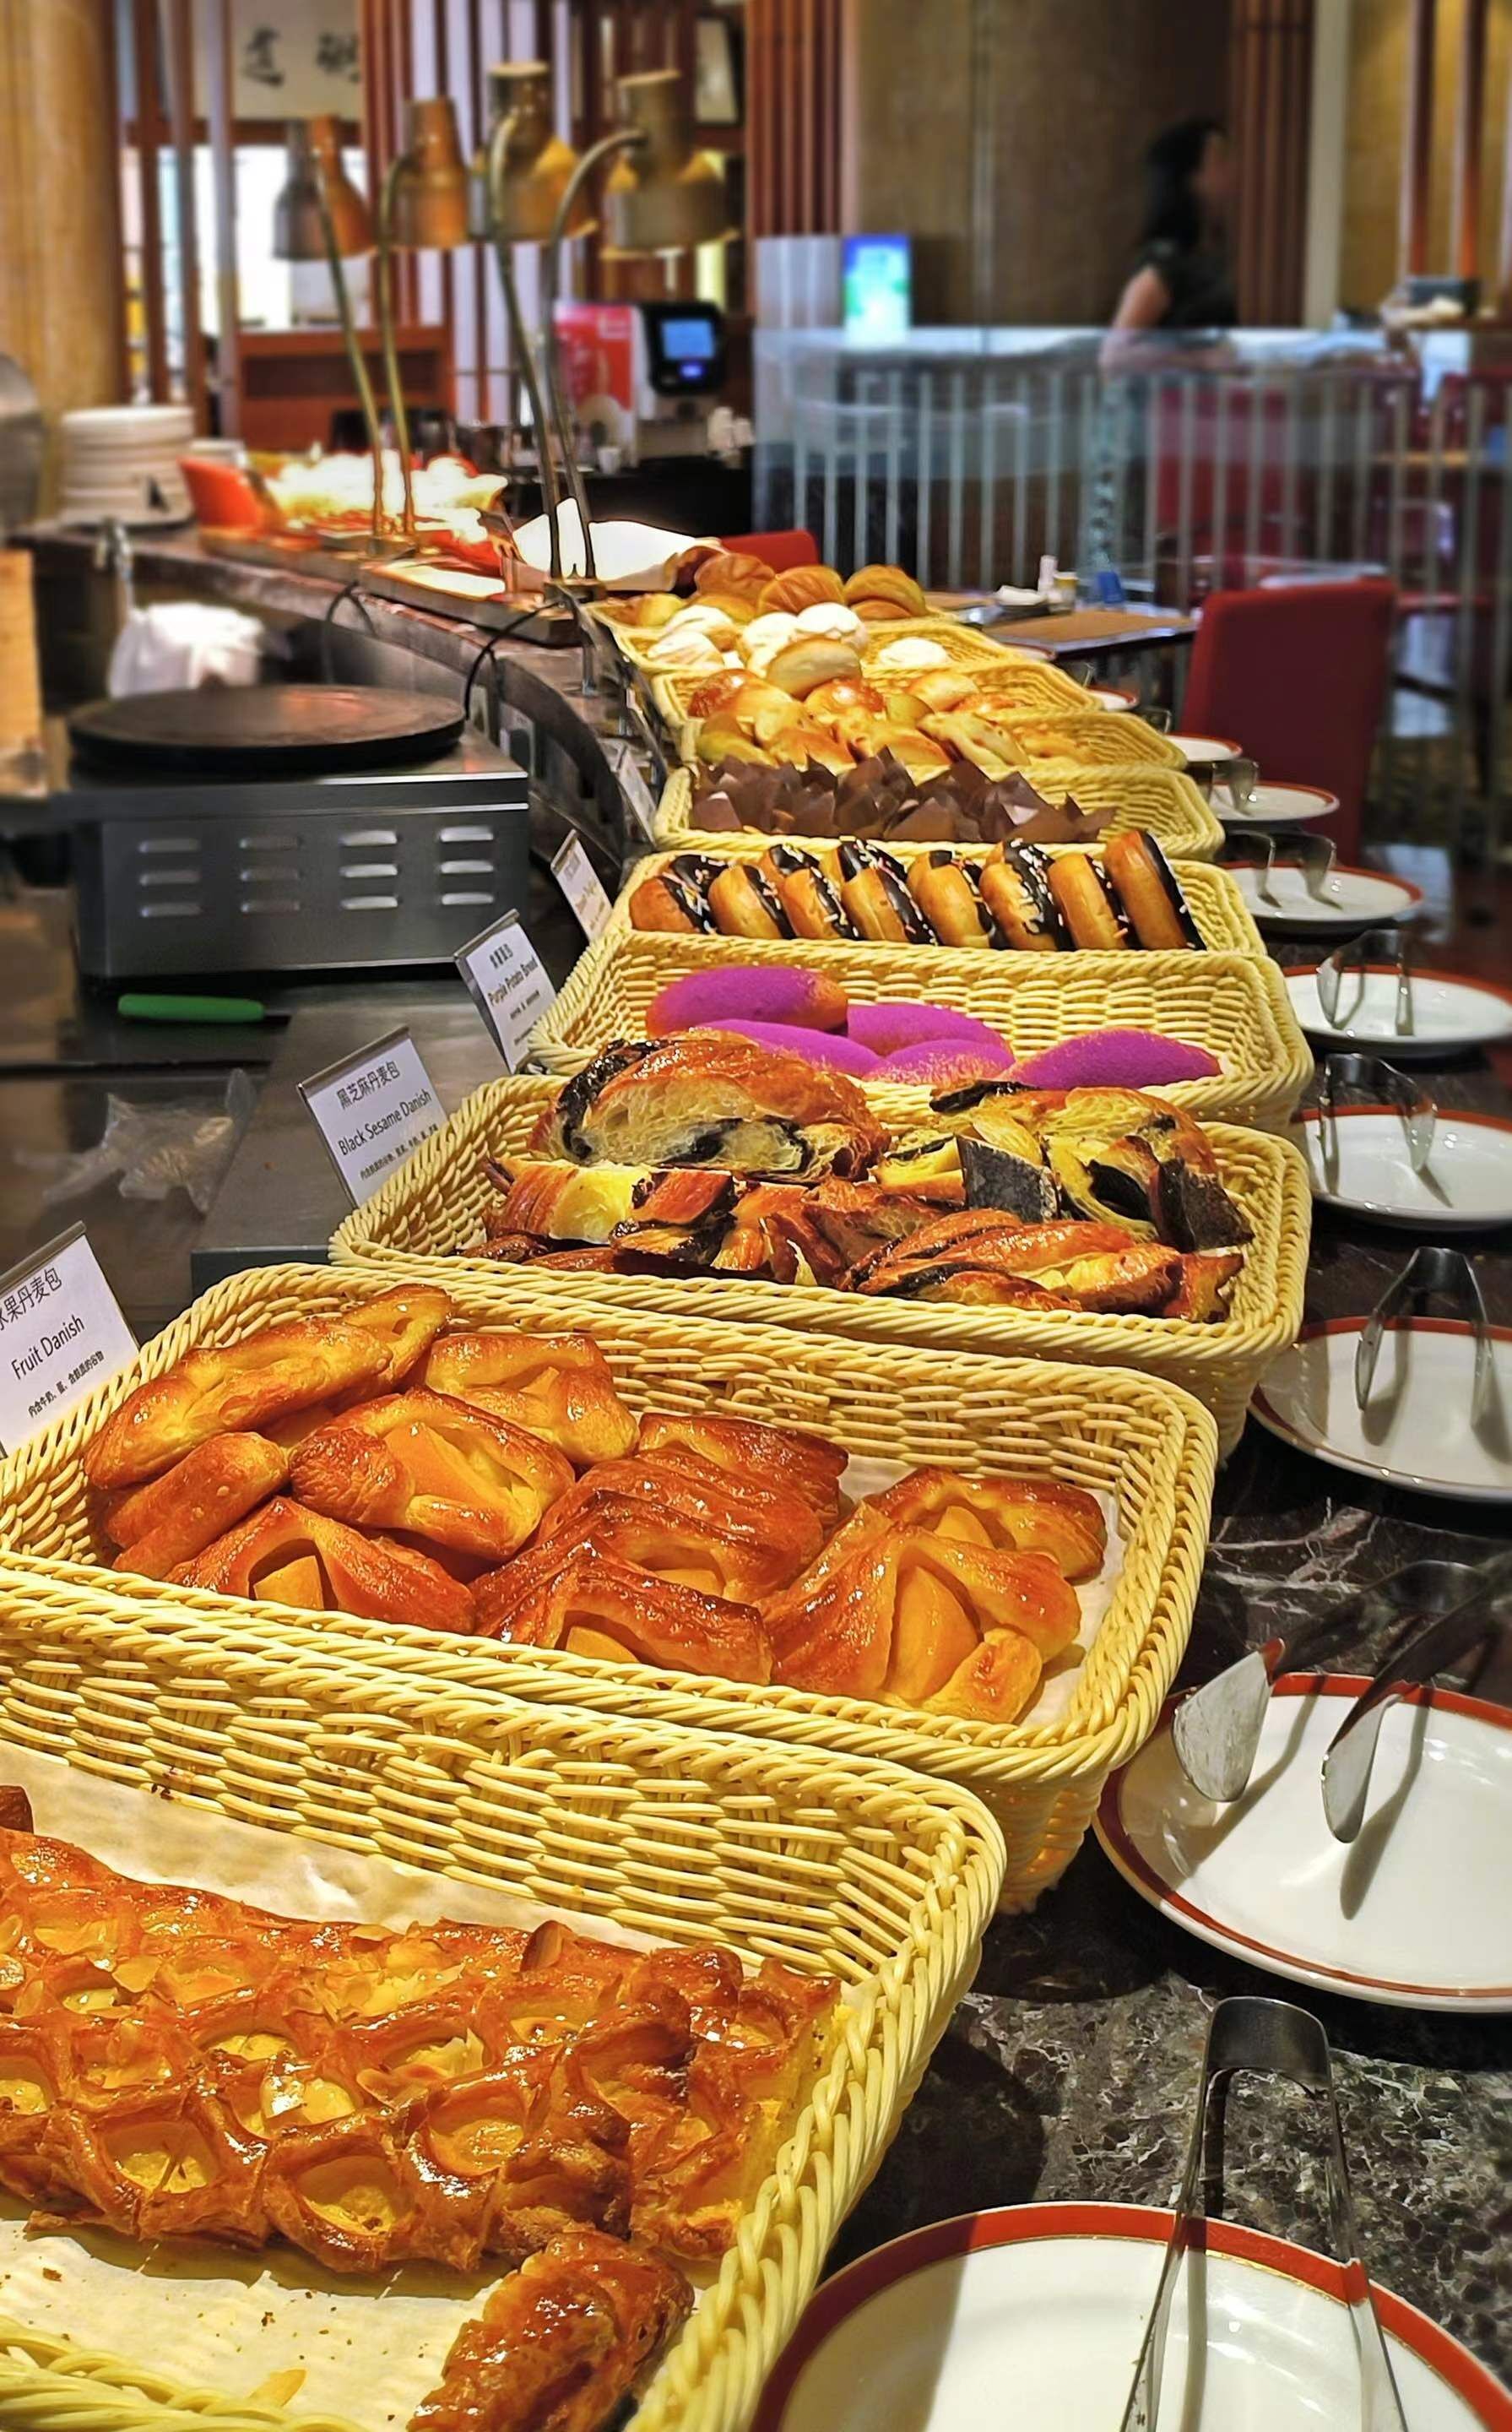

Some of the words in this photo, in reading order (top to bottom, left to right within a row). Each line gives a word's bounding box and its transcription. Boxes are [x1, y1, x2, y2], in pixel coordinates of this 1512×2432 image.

[336, 1061, 401, 1110] 黑芝麻丹麦包
[339, 1128, 366, 1156] Black
[365, 1109, 402, 1141] Sesame
[399, 1088, 432, 1117] Danish
[11, 1344, 43, 1381] Fruit
[41, 1314, 85, 1358] Danish
